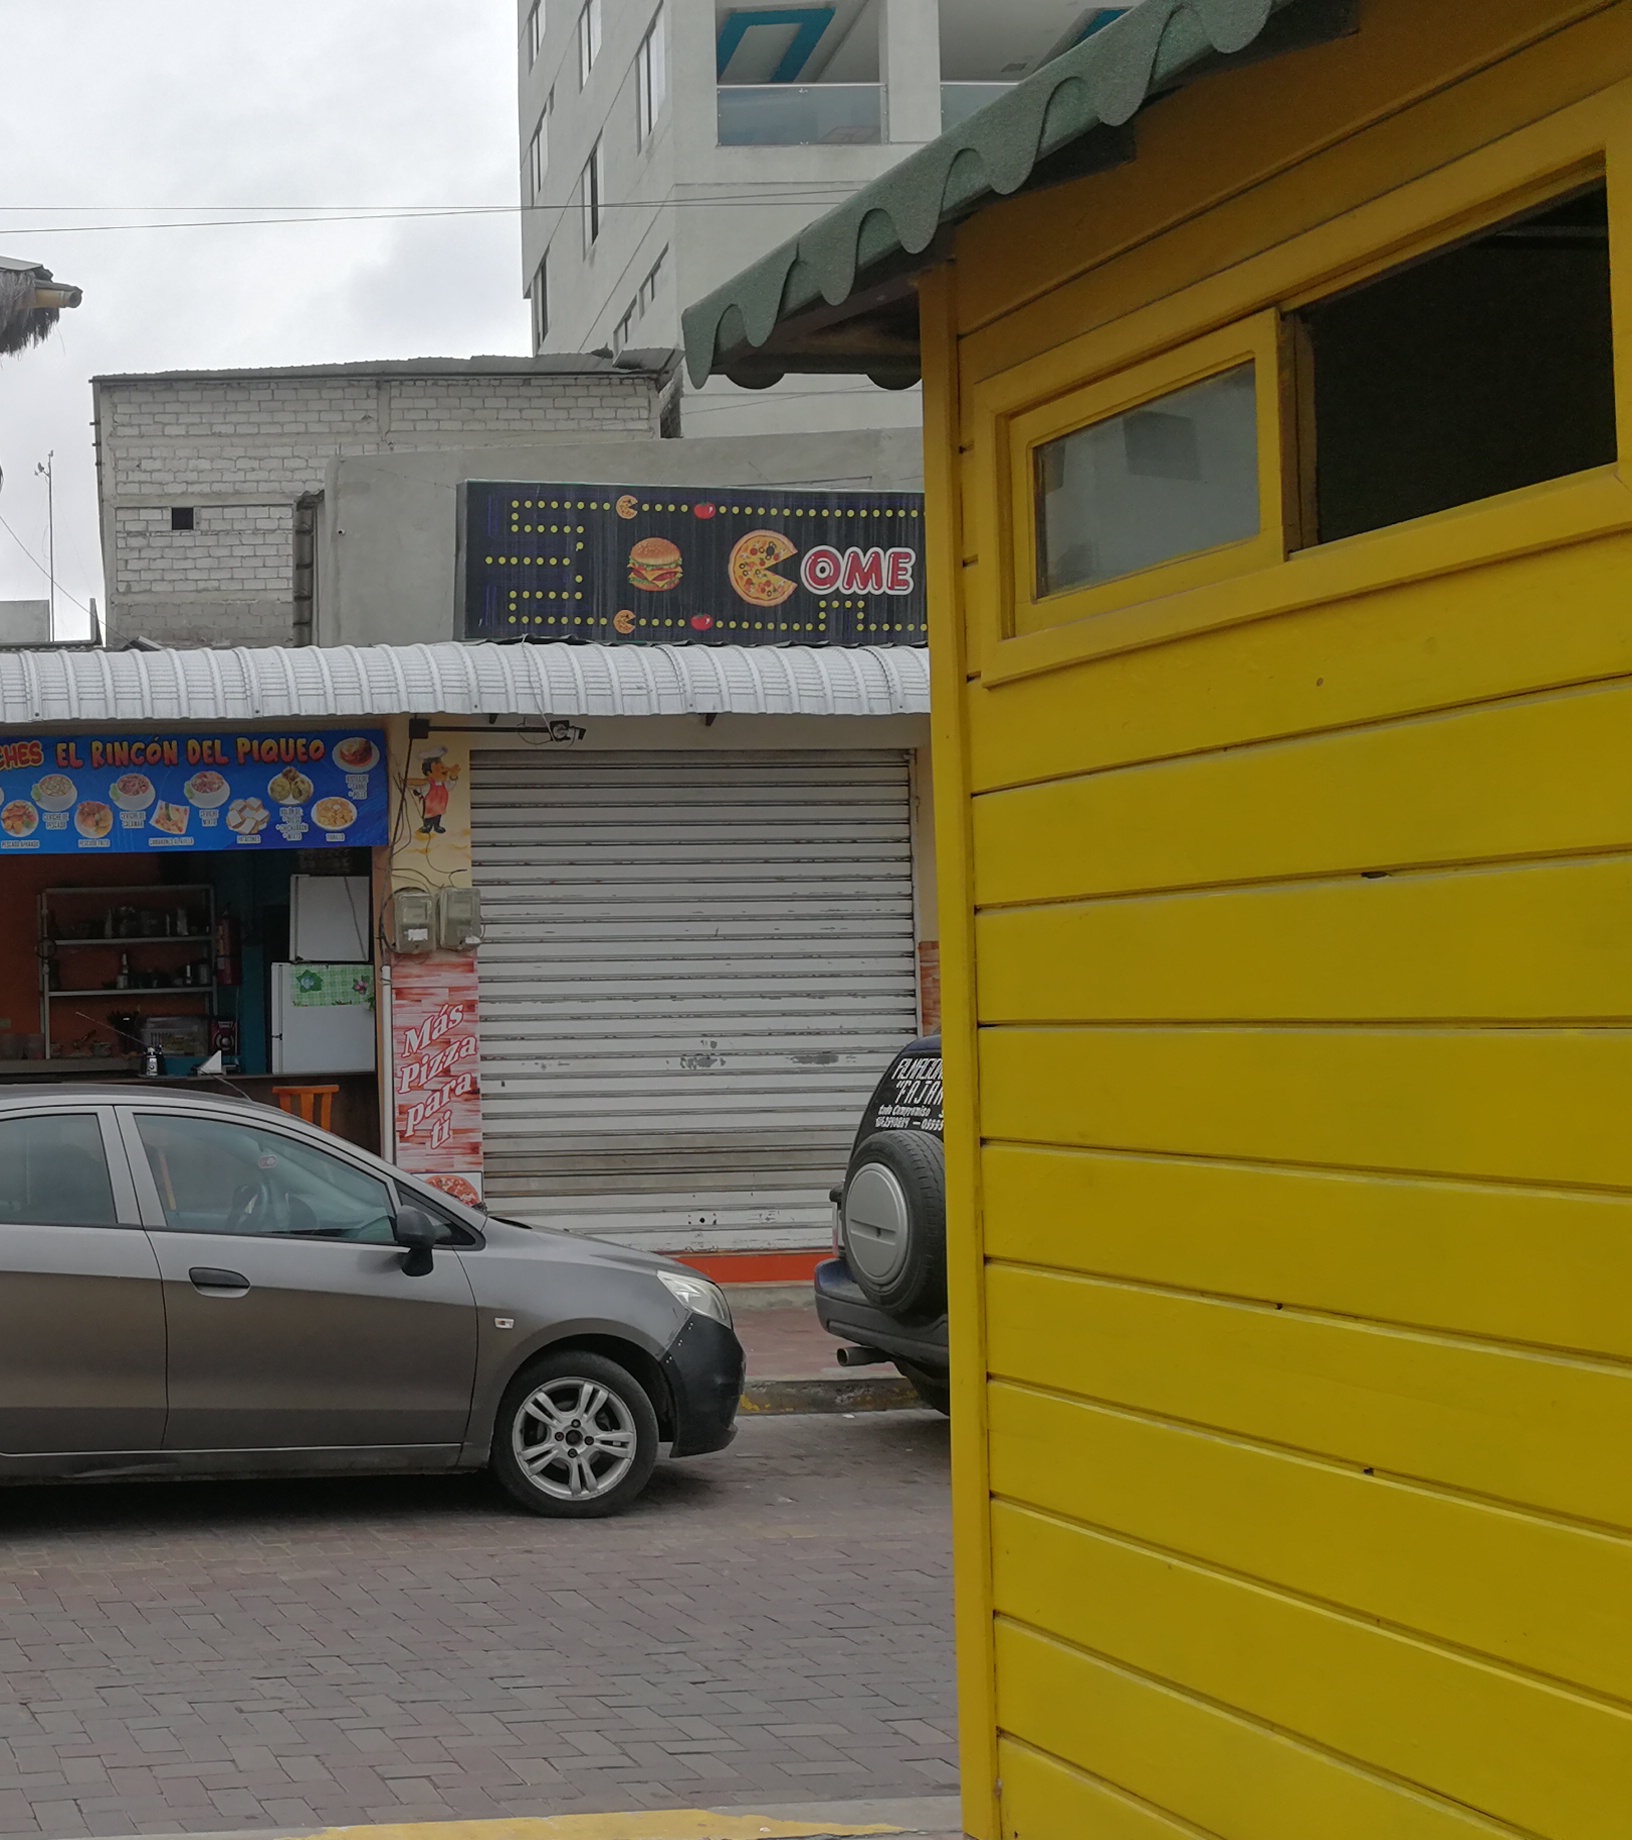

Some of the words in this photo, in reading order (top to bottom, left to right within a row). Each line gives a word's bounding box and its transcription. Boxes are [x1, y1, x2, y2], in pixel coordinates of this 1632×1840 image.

[56, 741, 84, 769] EL
[90, 736, 179, 768] RINCÓN
[186, 738, 229, 766] DEL
[236, 737, 326, 765] PIQUEO
[401, 1003, 464, 1058] Más
[398, 1036, 477, 1094] Pizza
[404, 1072, 473, 1137] para
[430, 1110, 452, 1150] ti
